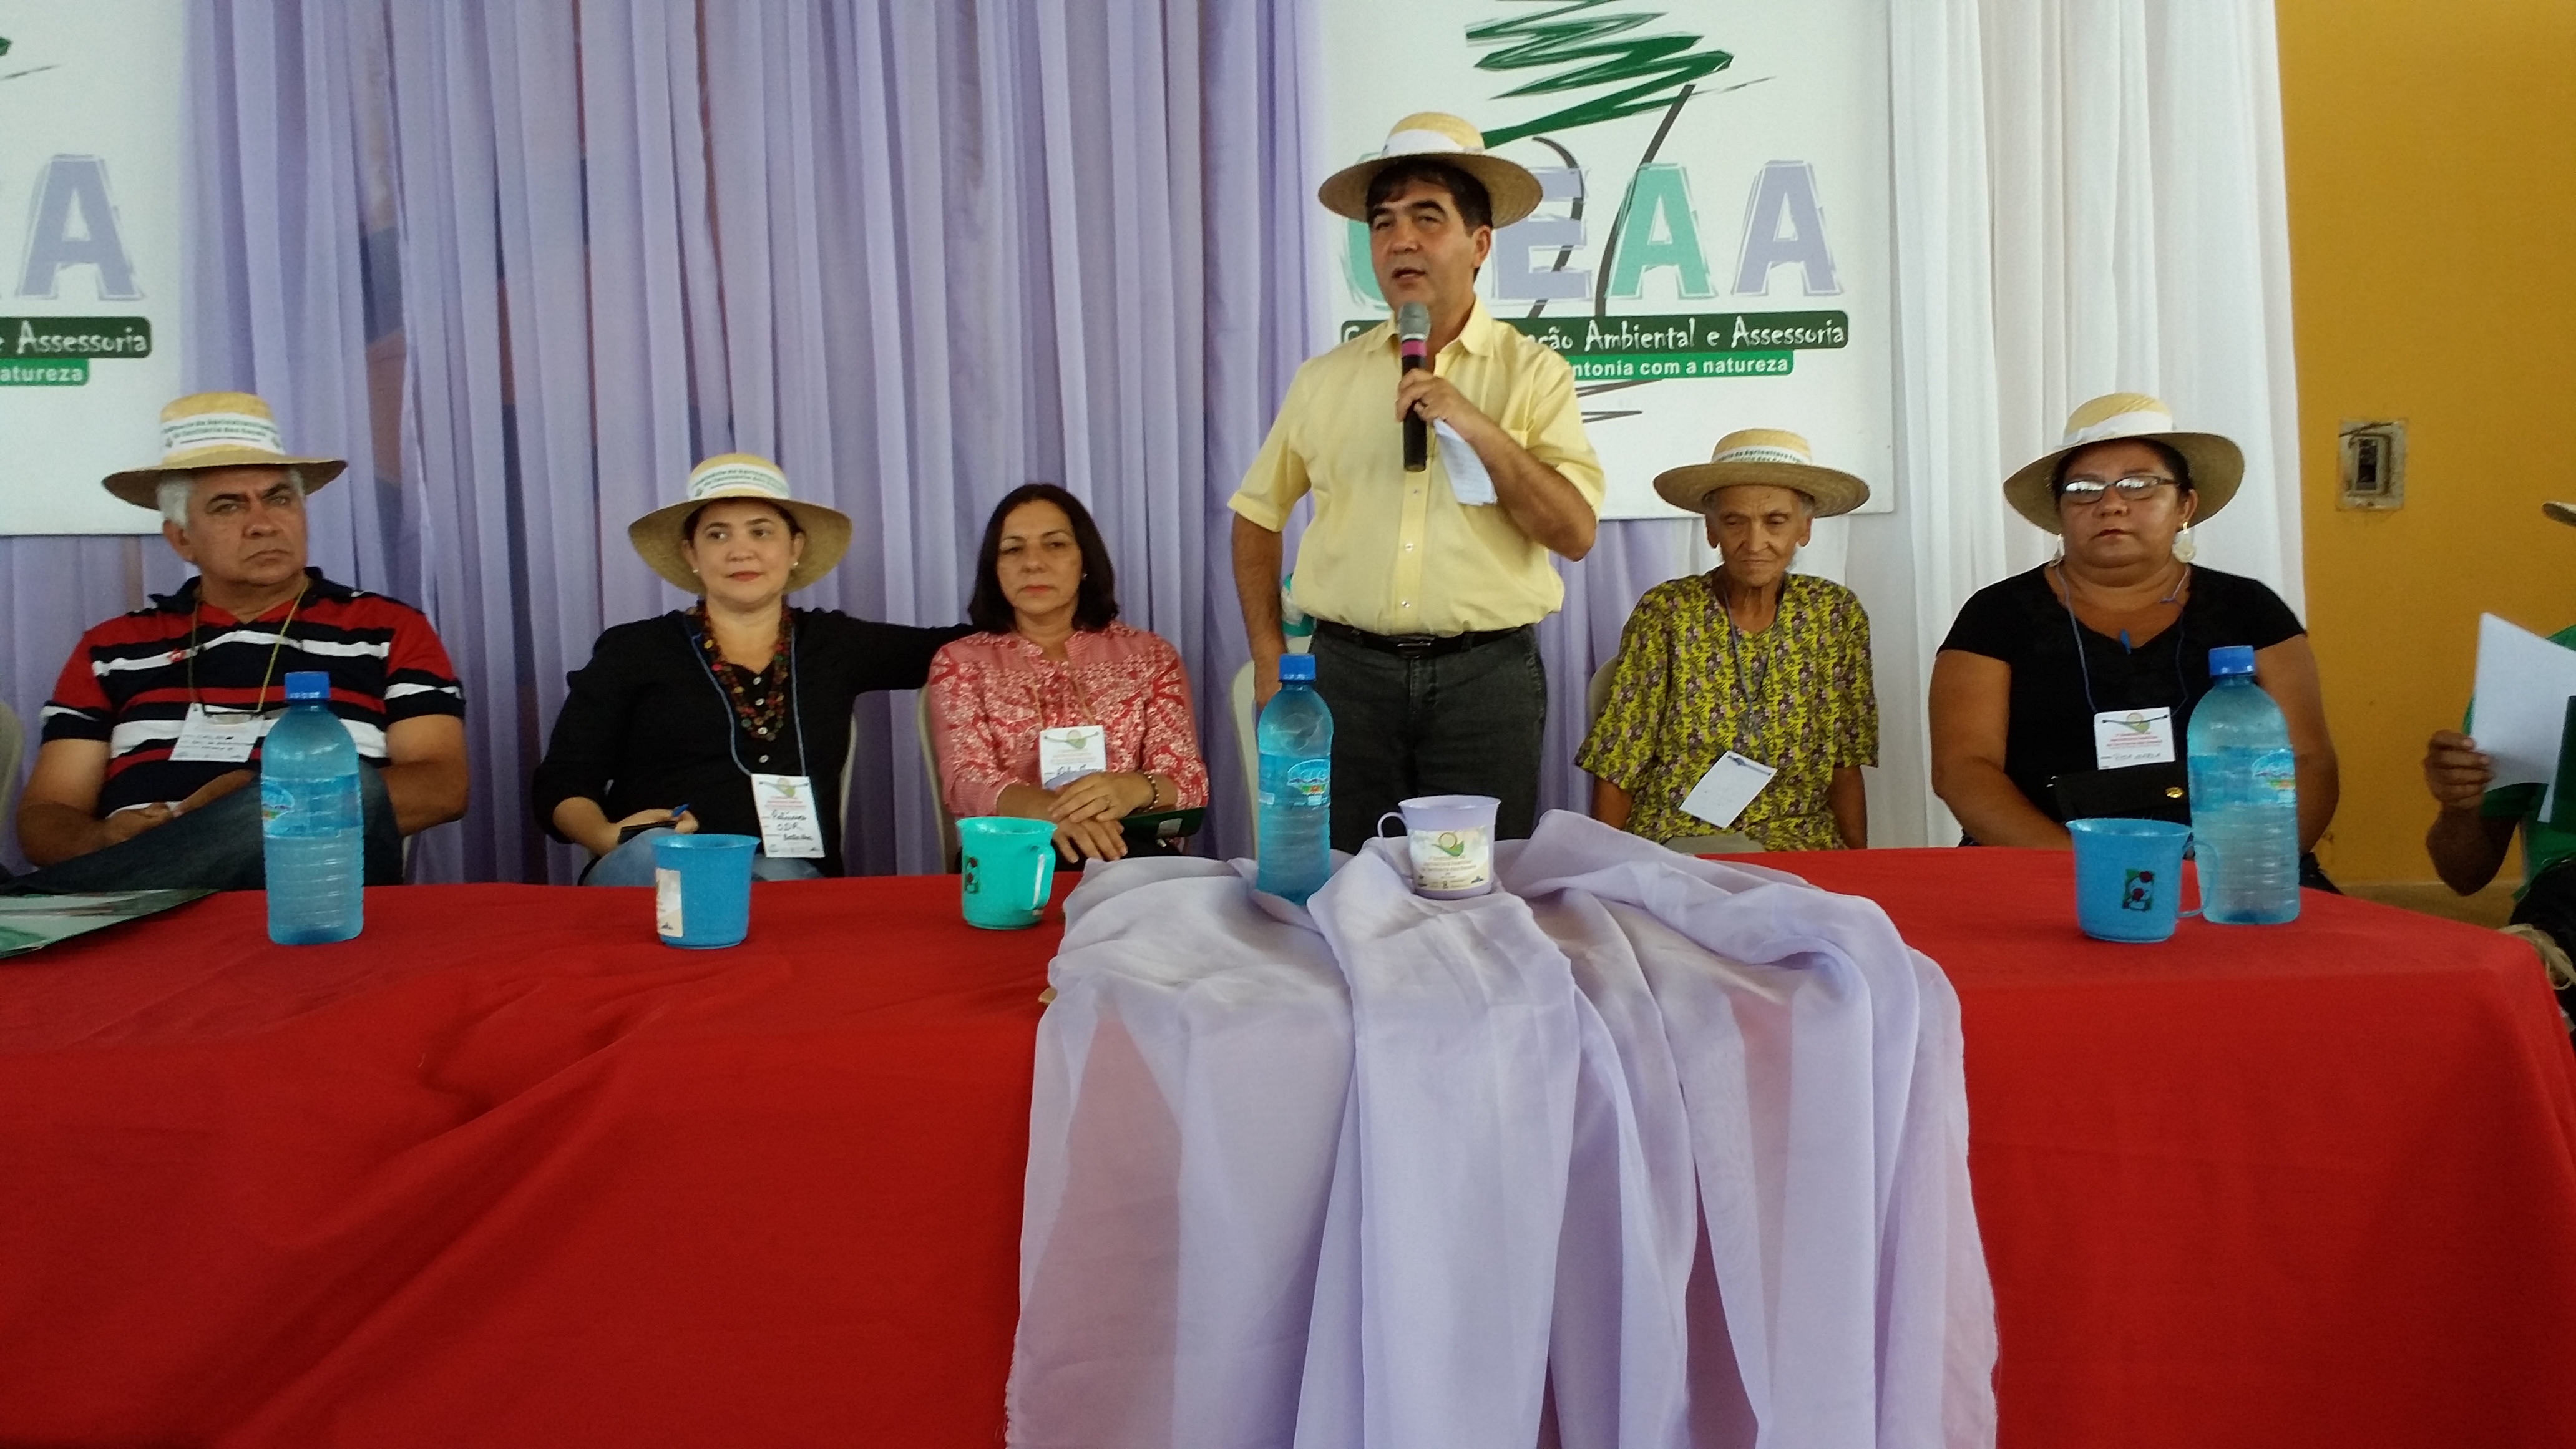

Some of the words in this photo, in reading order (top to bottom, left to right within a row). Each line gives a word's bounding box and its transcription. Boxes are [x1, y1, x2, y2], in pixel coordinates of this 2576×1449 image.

[17, 320, 147, 354] Assessoria
[1527, 326, 1573, 349] ão
[1584, 318, 1695, 352] Ambiental
[1707, 331, 1720, 347] e
[1730, 315, 1845, 349] Assessoria
[1567, 359, 1634, 376] ntonia
[1640, 361, 1680, 375] com
[1686, 361, 1697, 374] a
[1703, 358, 1788, 374] natureza
